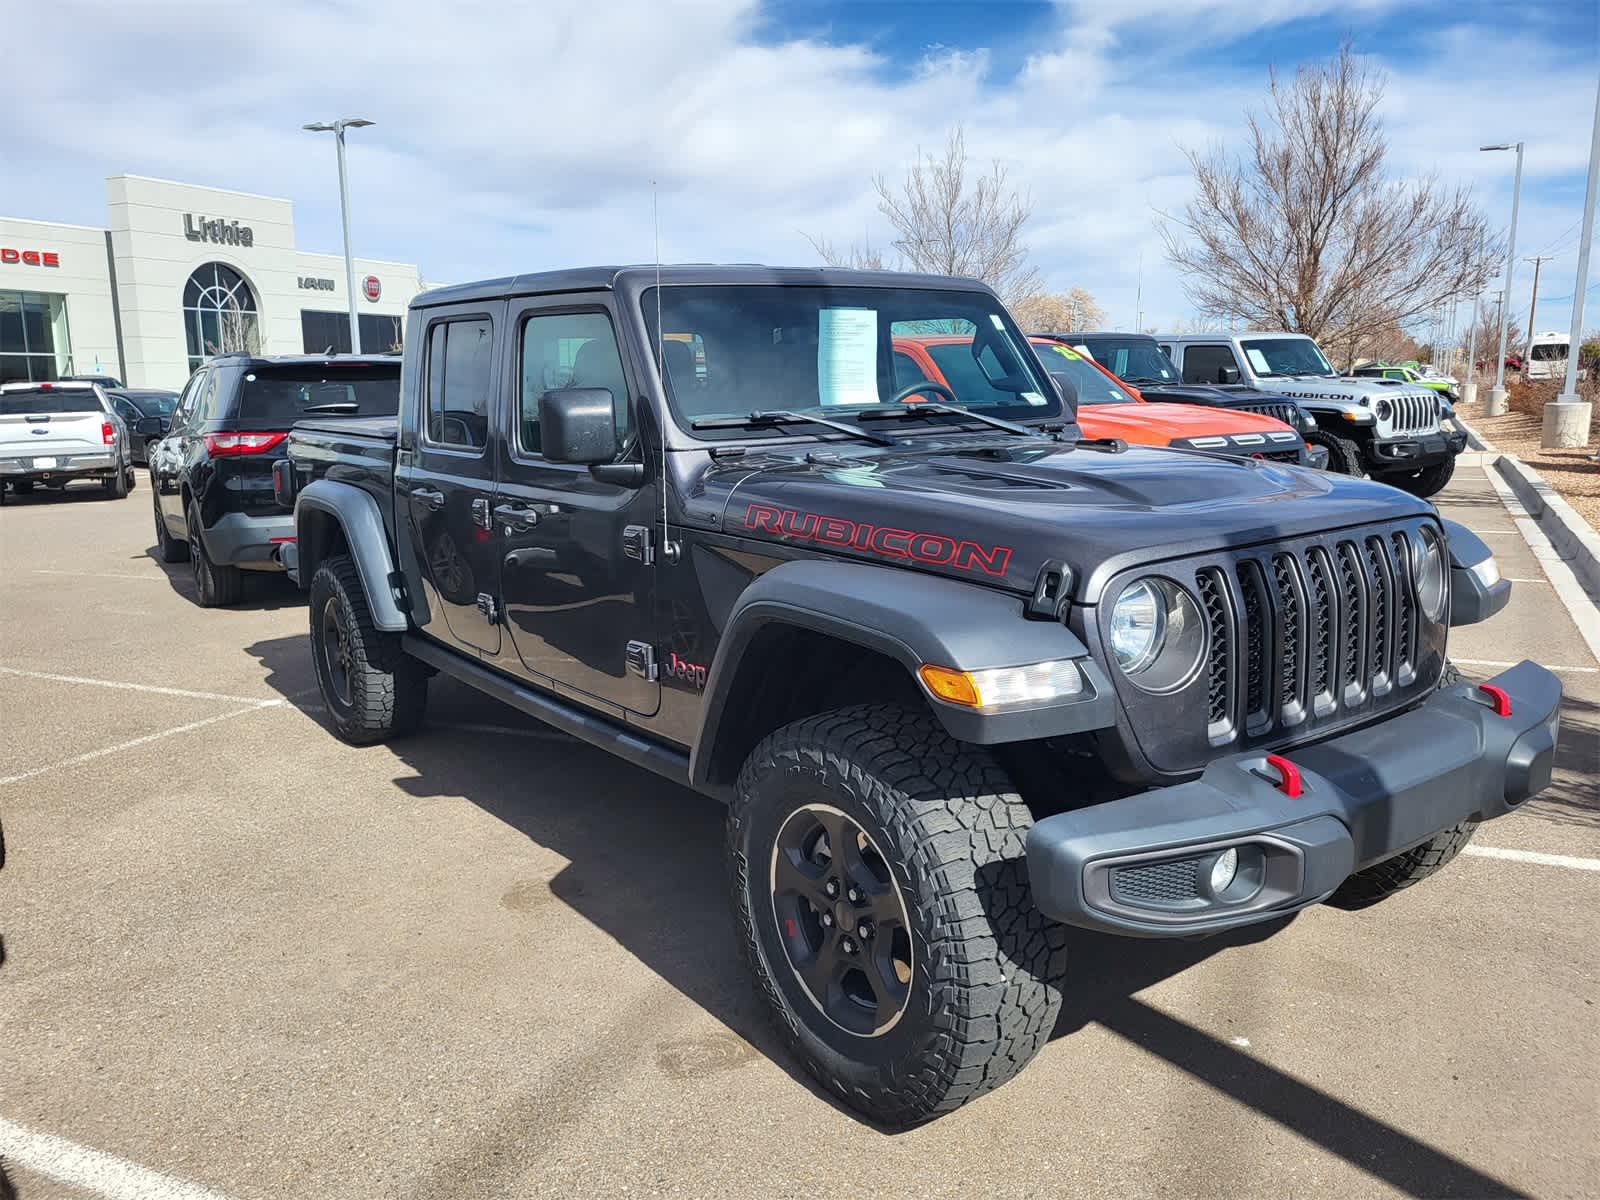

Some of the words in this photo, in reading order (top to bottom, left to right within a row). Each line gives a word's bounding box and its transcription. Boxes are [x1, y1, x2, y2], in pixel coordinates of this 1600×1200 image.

[183, 213, 254, 248] Lithia
[1280, 391, 1354, 401] RUBICON
[744, 503, 1013, 577] RUBICON
[664, 651, 706, 689] Jeep
